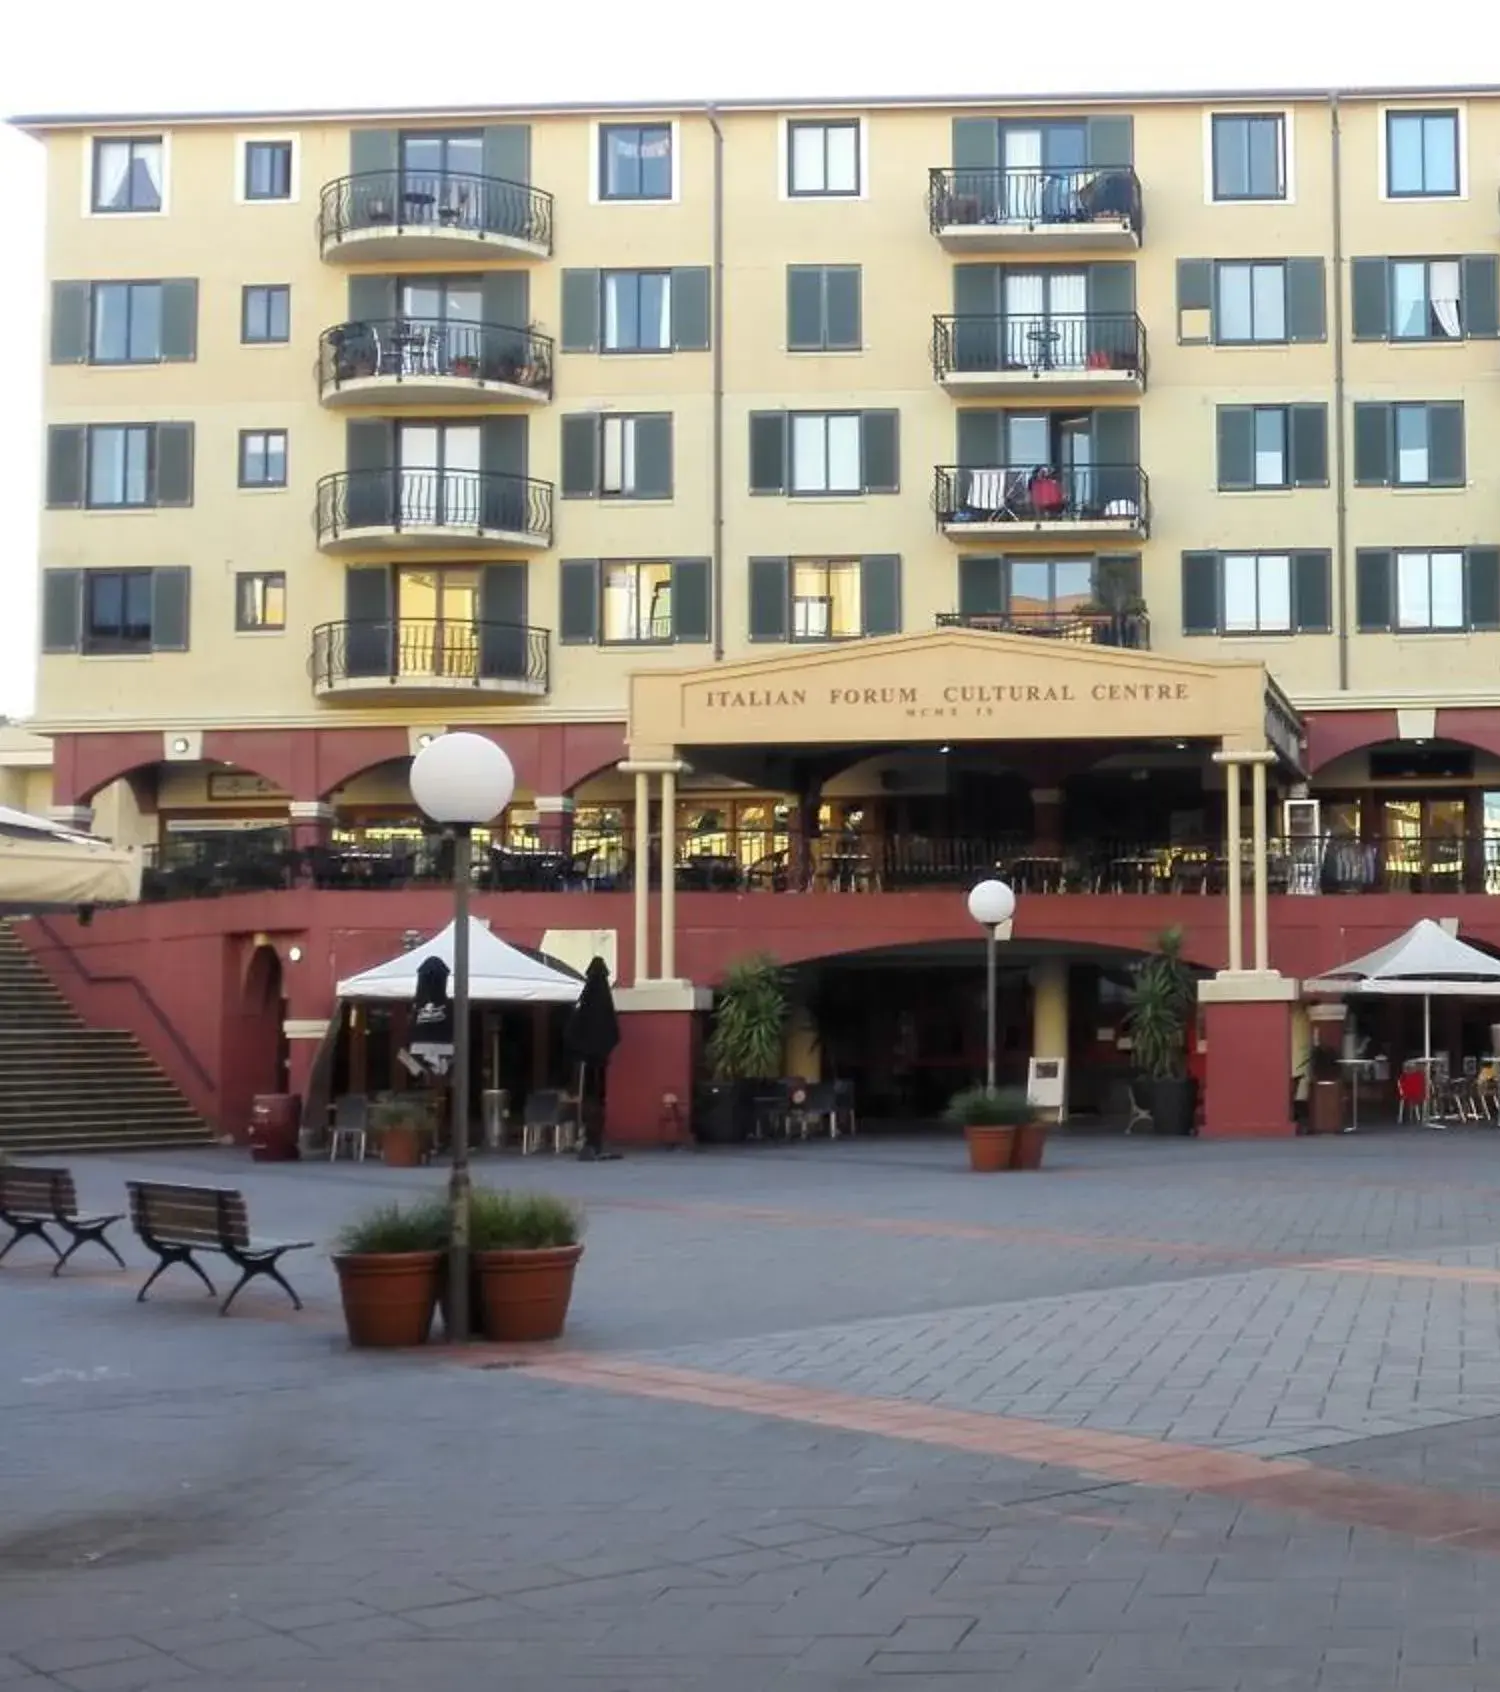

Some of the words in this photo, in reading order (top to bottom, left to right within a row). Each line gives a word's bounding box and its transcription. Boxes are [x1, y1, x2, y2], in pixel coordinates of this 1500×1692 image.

[706, 690, 806, 707] ITALIAN
[829, 687, 917, 705] FORUM
[943, 685, 1075, 703] CULTURAL
[1091, 683, 1189, 700] CENTRE
